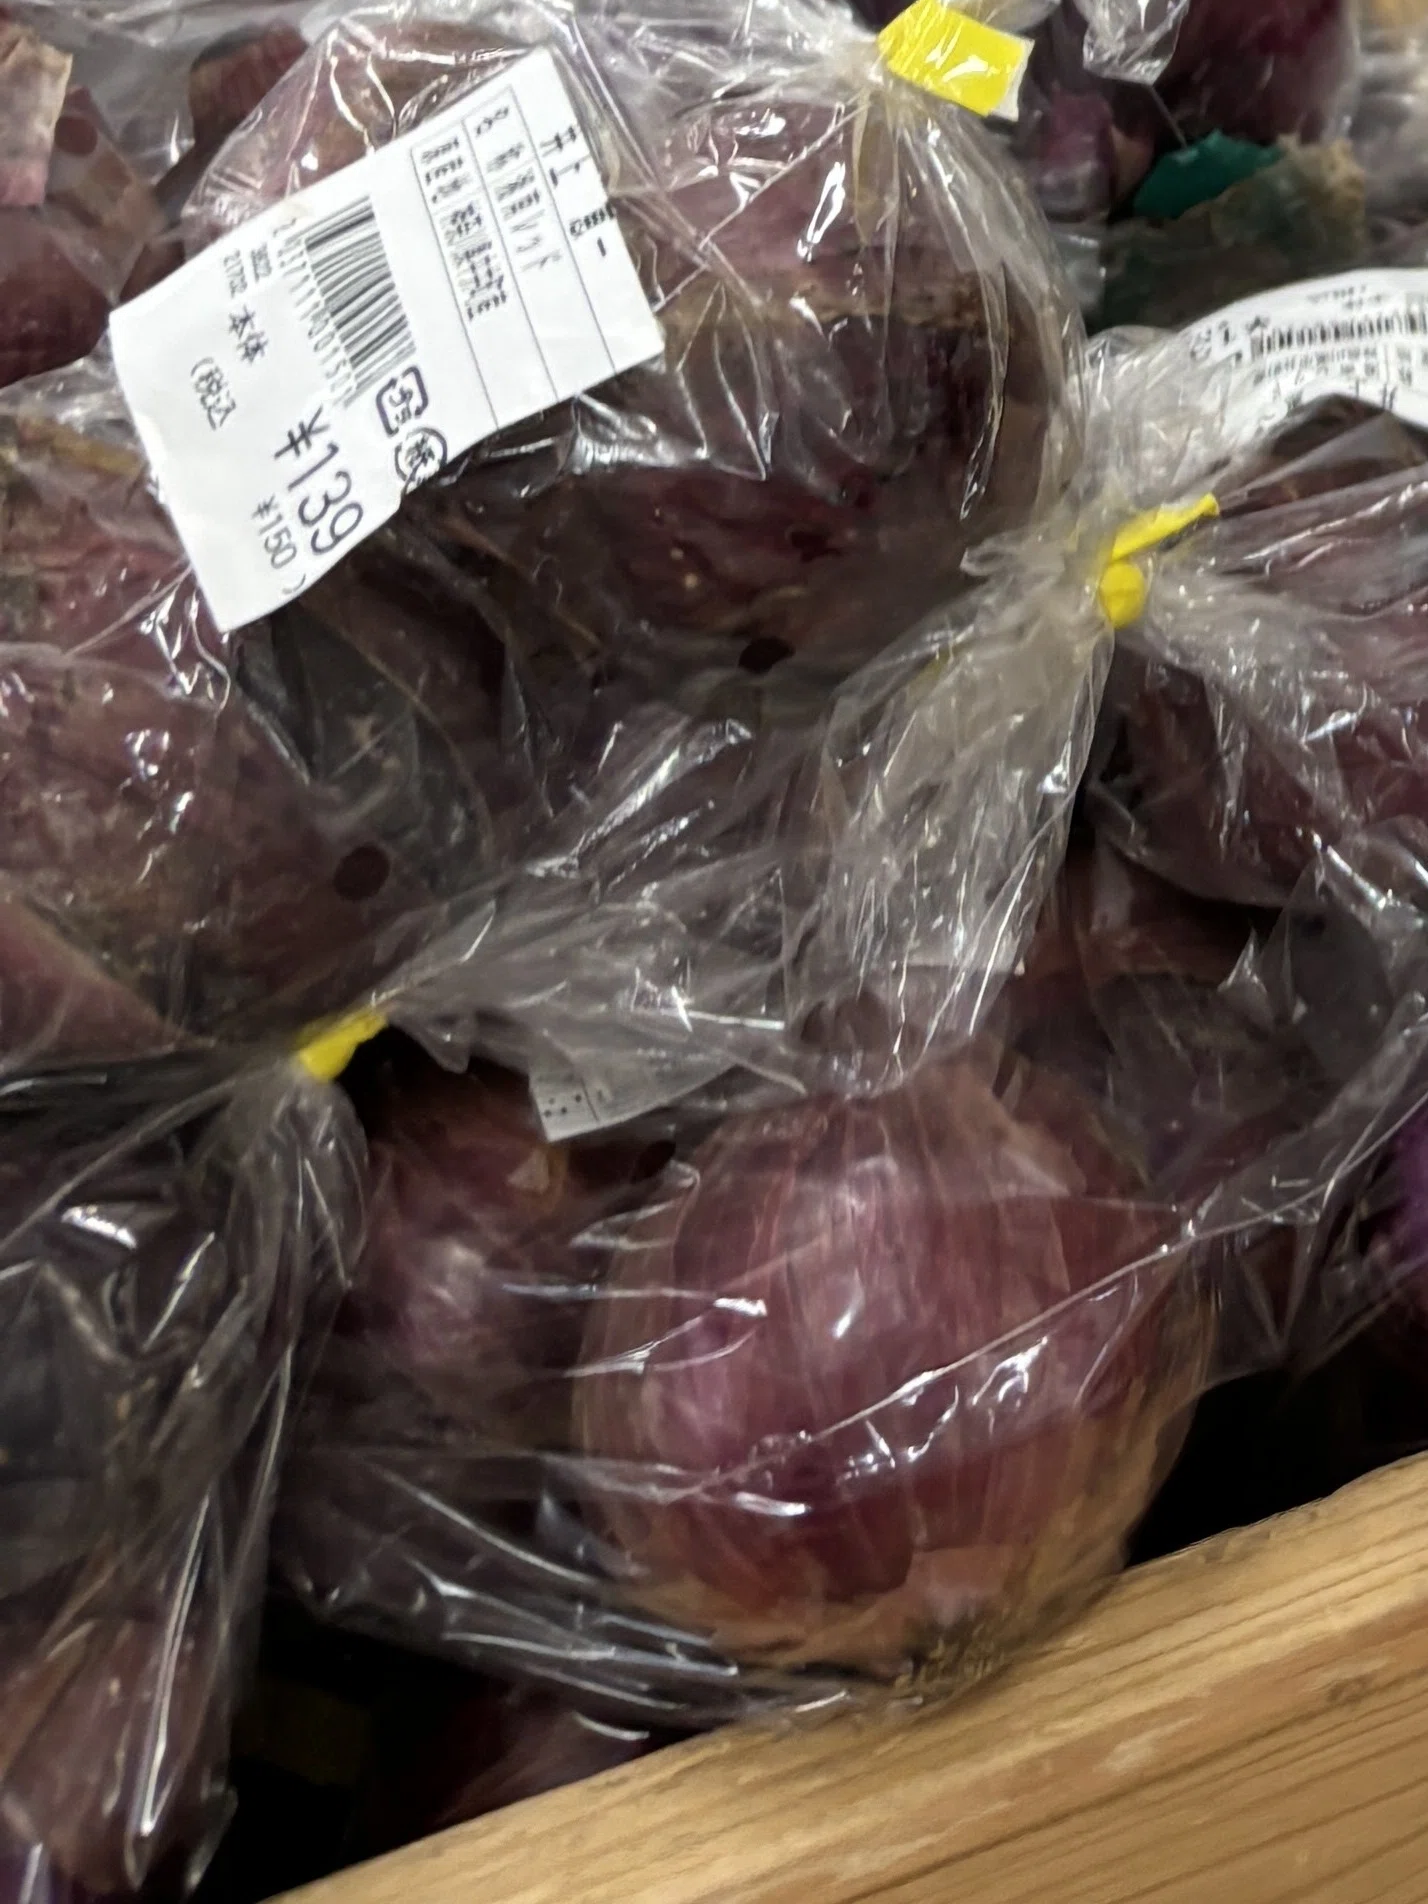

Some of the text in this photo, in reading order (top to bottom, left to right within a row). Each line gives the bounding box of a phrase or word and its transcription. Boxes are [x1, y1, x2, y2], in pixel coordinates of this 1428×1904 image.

[228, 303, 365, 555] 本体 ¥139
[251, 499, 298, 567] ¥150
